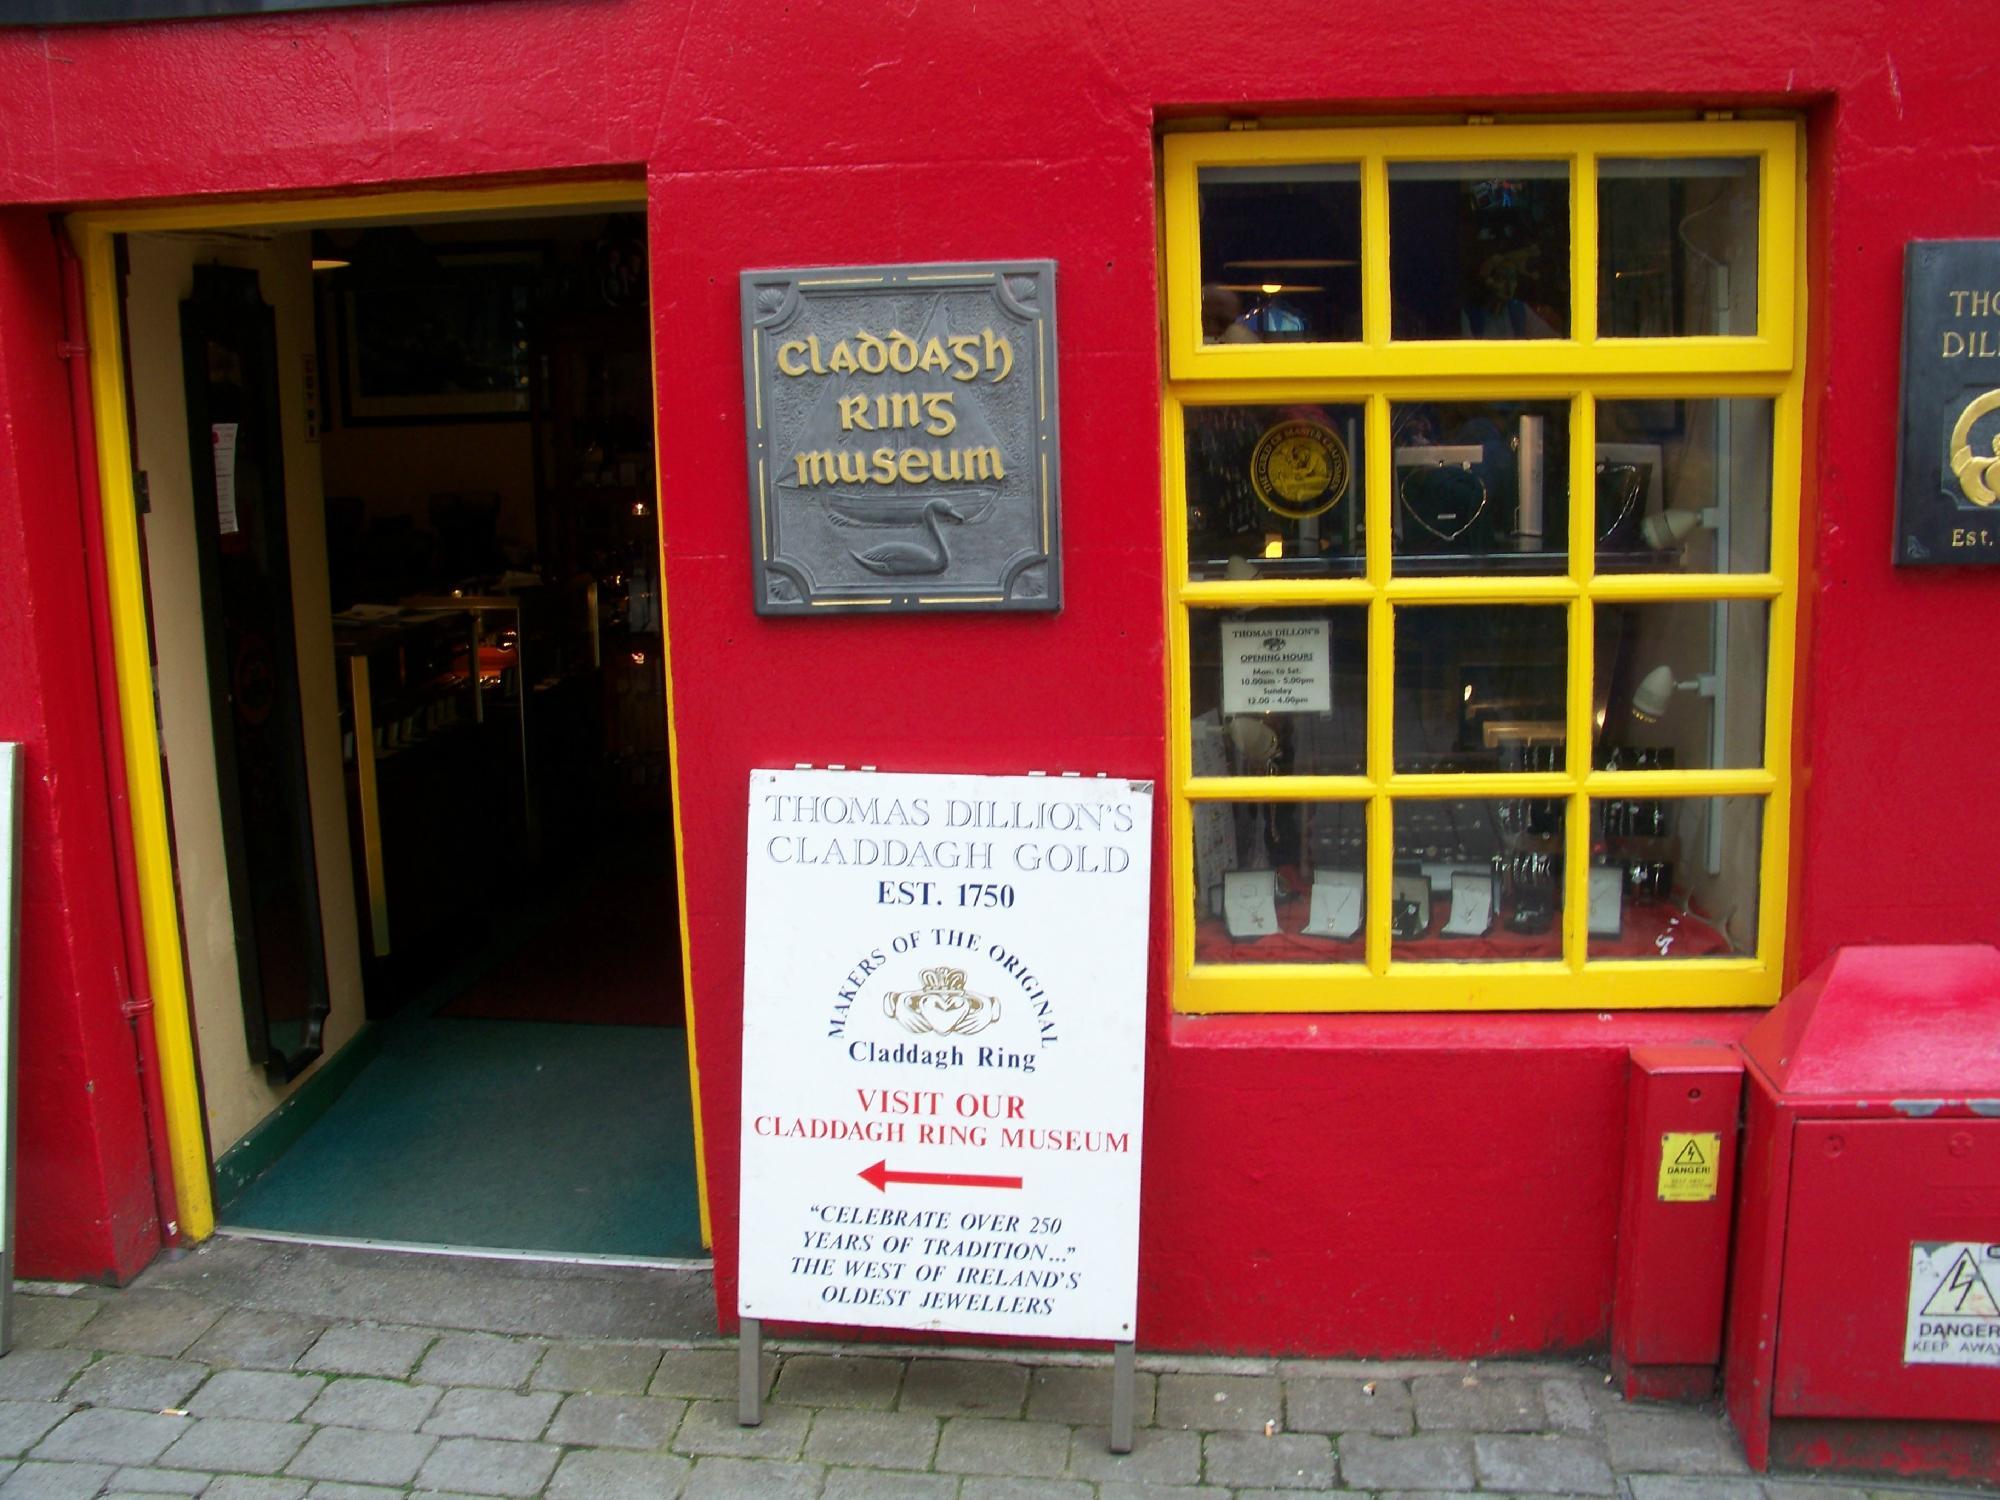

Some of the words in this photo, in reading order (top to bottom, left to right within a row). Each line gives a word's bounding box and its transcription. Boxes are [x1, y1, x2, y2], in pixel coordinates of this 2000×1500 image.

[1942, 331, 2000, 358] DIL
[1951, 528, 1993, 547] Est.
[1232, 630, 1273, 638] THOMAS
[1283, 653, 1313, 661] HOURS
[765, 795, 930, 828] THOMAS
[945, 798, 1134, 833] DILLION'S
[766, 836, 993, 870] CLADDAGH
[1013, 843, 1130, 874] GOLD
[877, 881, 942, 906] EST.
[957, 883, 1015, 909] 1750
[828, 948, 887, 1039] MAKERS
[892, 931, 921, 954] OF
[931, 928, 980, 951] THE
[989, 944, 1059, 1048] ORIGINAL
[848, 1040, 964, 1070] Claddagh
[977, 1046, 1037, 1073] Ring
[857, 1088, 944, 1116] VISIT
[956, 1092, 1026, 1119] OUR
[754, 1116, 904, 1143] CLADDAGH
[919, 1124, 987, 1147] RING
[1000, 1127, 1129, 1153] MUSEUM
[960, 1212, 1020, 1233] OVER
[1029, 1216, 1062, 1235] 250
[803, 1230, 872, 1253] YEARS
[882, 1235, 912, 1255] OF
[790, 1256, 835, 1277] THE
[843, 1260, 907, 1281] WEST
[915, 1264, 947, 1283] OF
[821, 1284, 911, 1308] OLDEST
[918, 1289, 1055, 1315] JEWELLERS
[1912, 1341, 1949, 1352] KEEP
